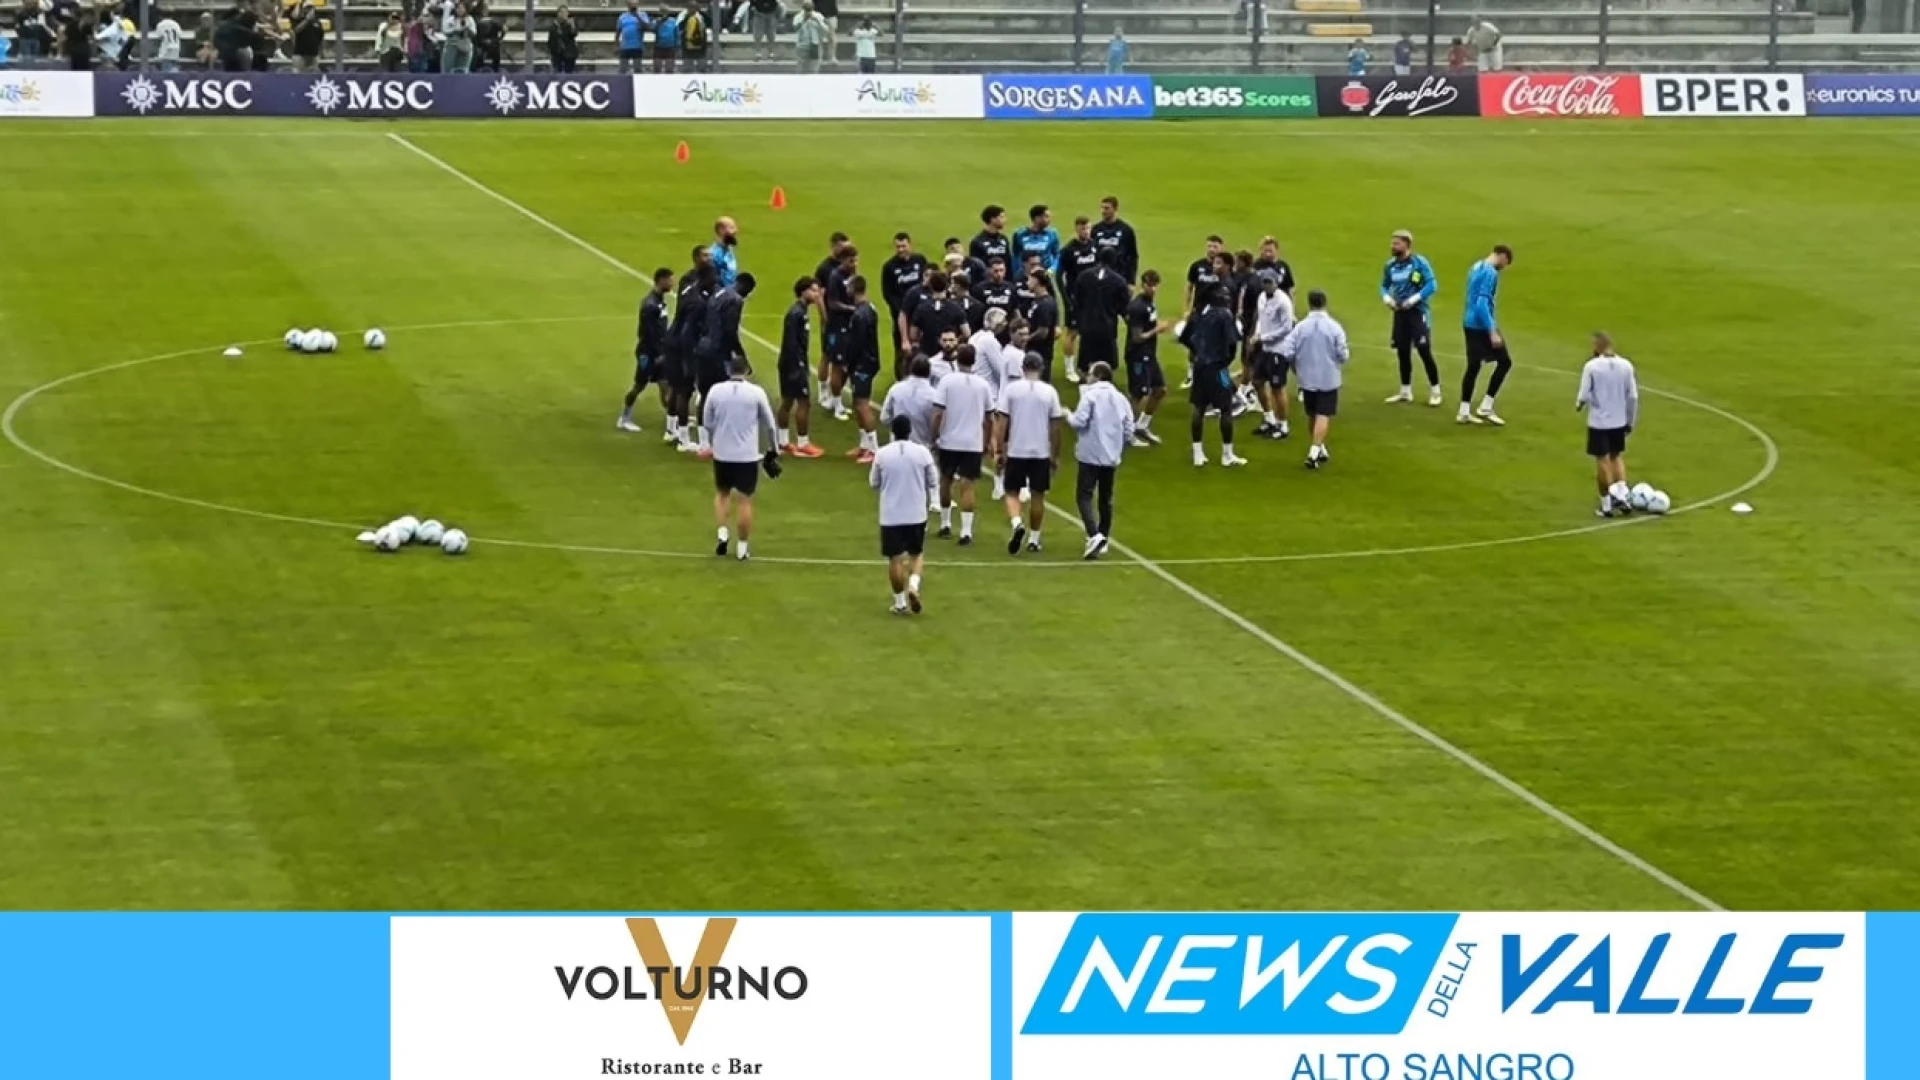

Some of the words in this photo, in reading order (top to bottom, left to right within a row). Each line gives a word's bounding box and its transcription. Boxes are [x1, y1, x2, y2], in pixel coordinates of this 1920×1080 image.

[164, 79, 252, 109] MSC
[345, 80, 433, 110] MSC
[525, 81, 610, 110] MSC
[1154, 85, 1243, 107] bet365
[1244, 92, 1312, 107] Scores
[1817, 85, 1896, 103] euronics
